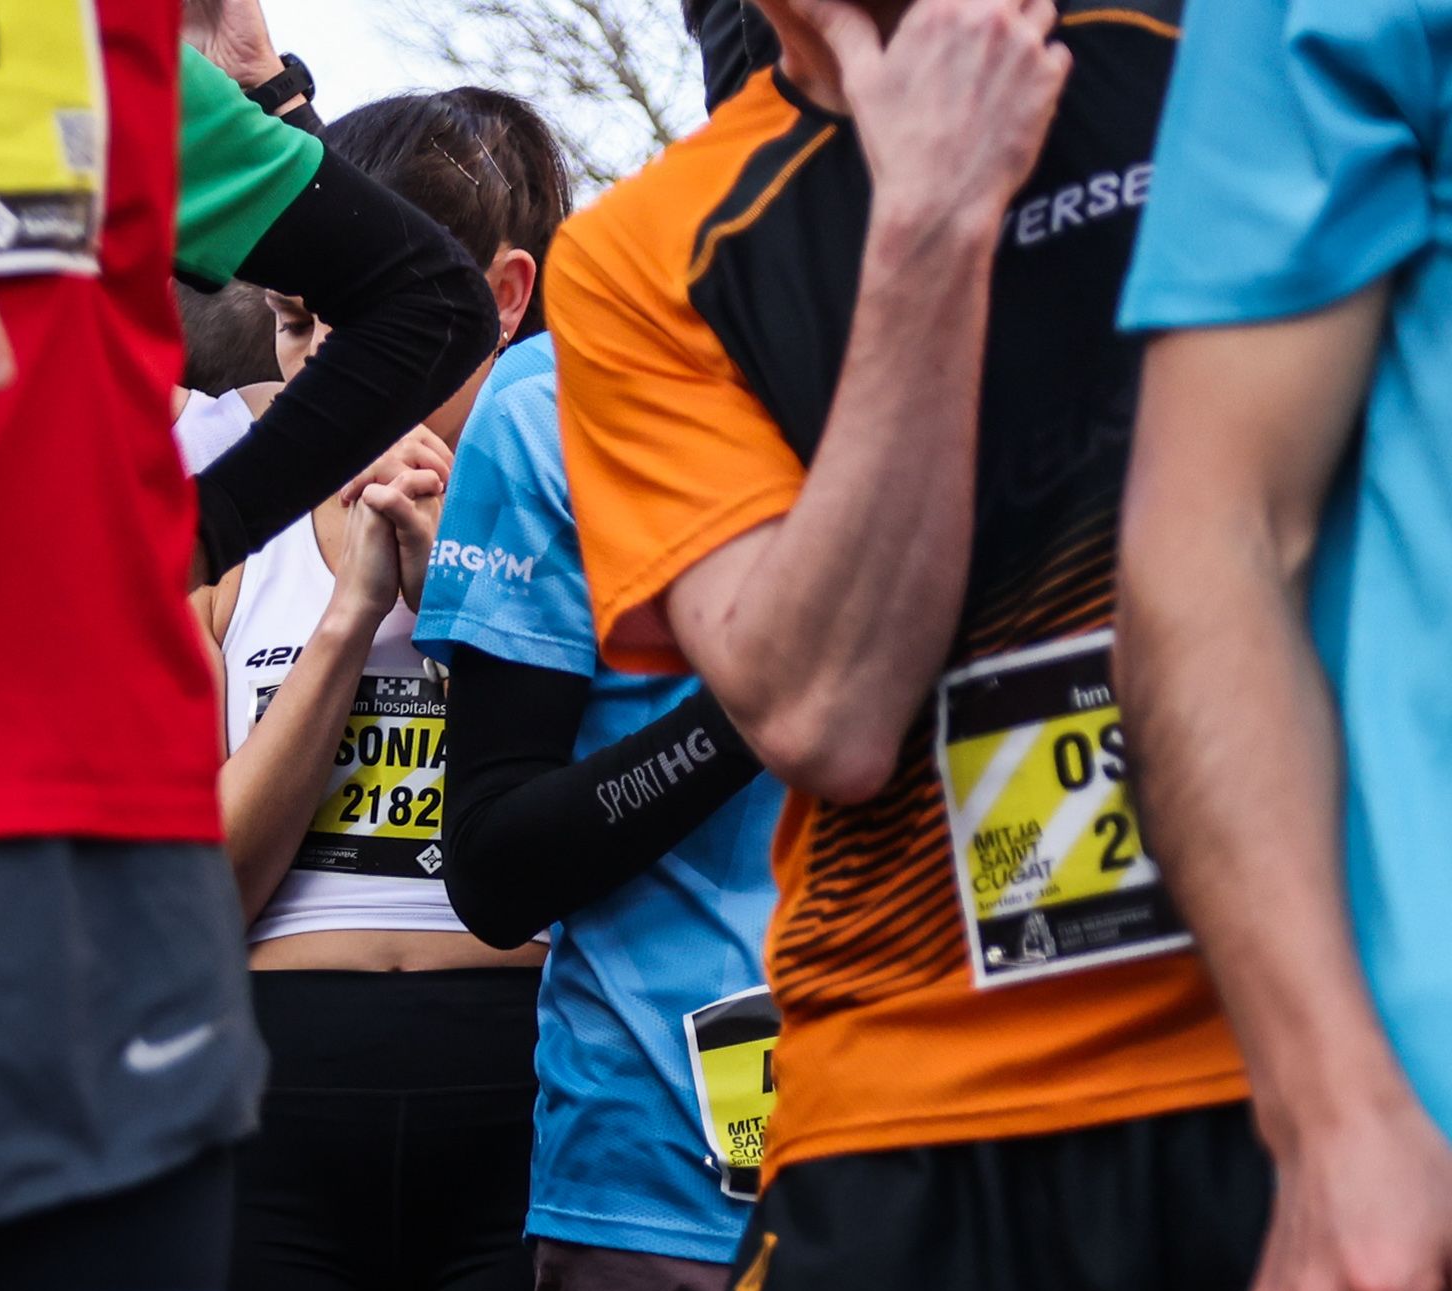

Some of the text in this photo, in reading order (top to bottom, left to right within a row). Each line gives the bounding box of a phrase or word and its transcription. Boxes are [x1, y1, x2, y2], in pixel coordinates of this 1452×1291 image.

[1001, 164, 1156, 246] ERSE
[374, 698, 447, 716] hospitales
[338, 783, 442, 829] 2182
